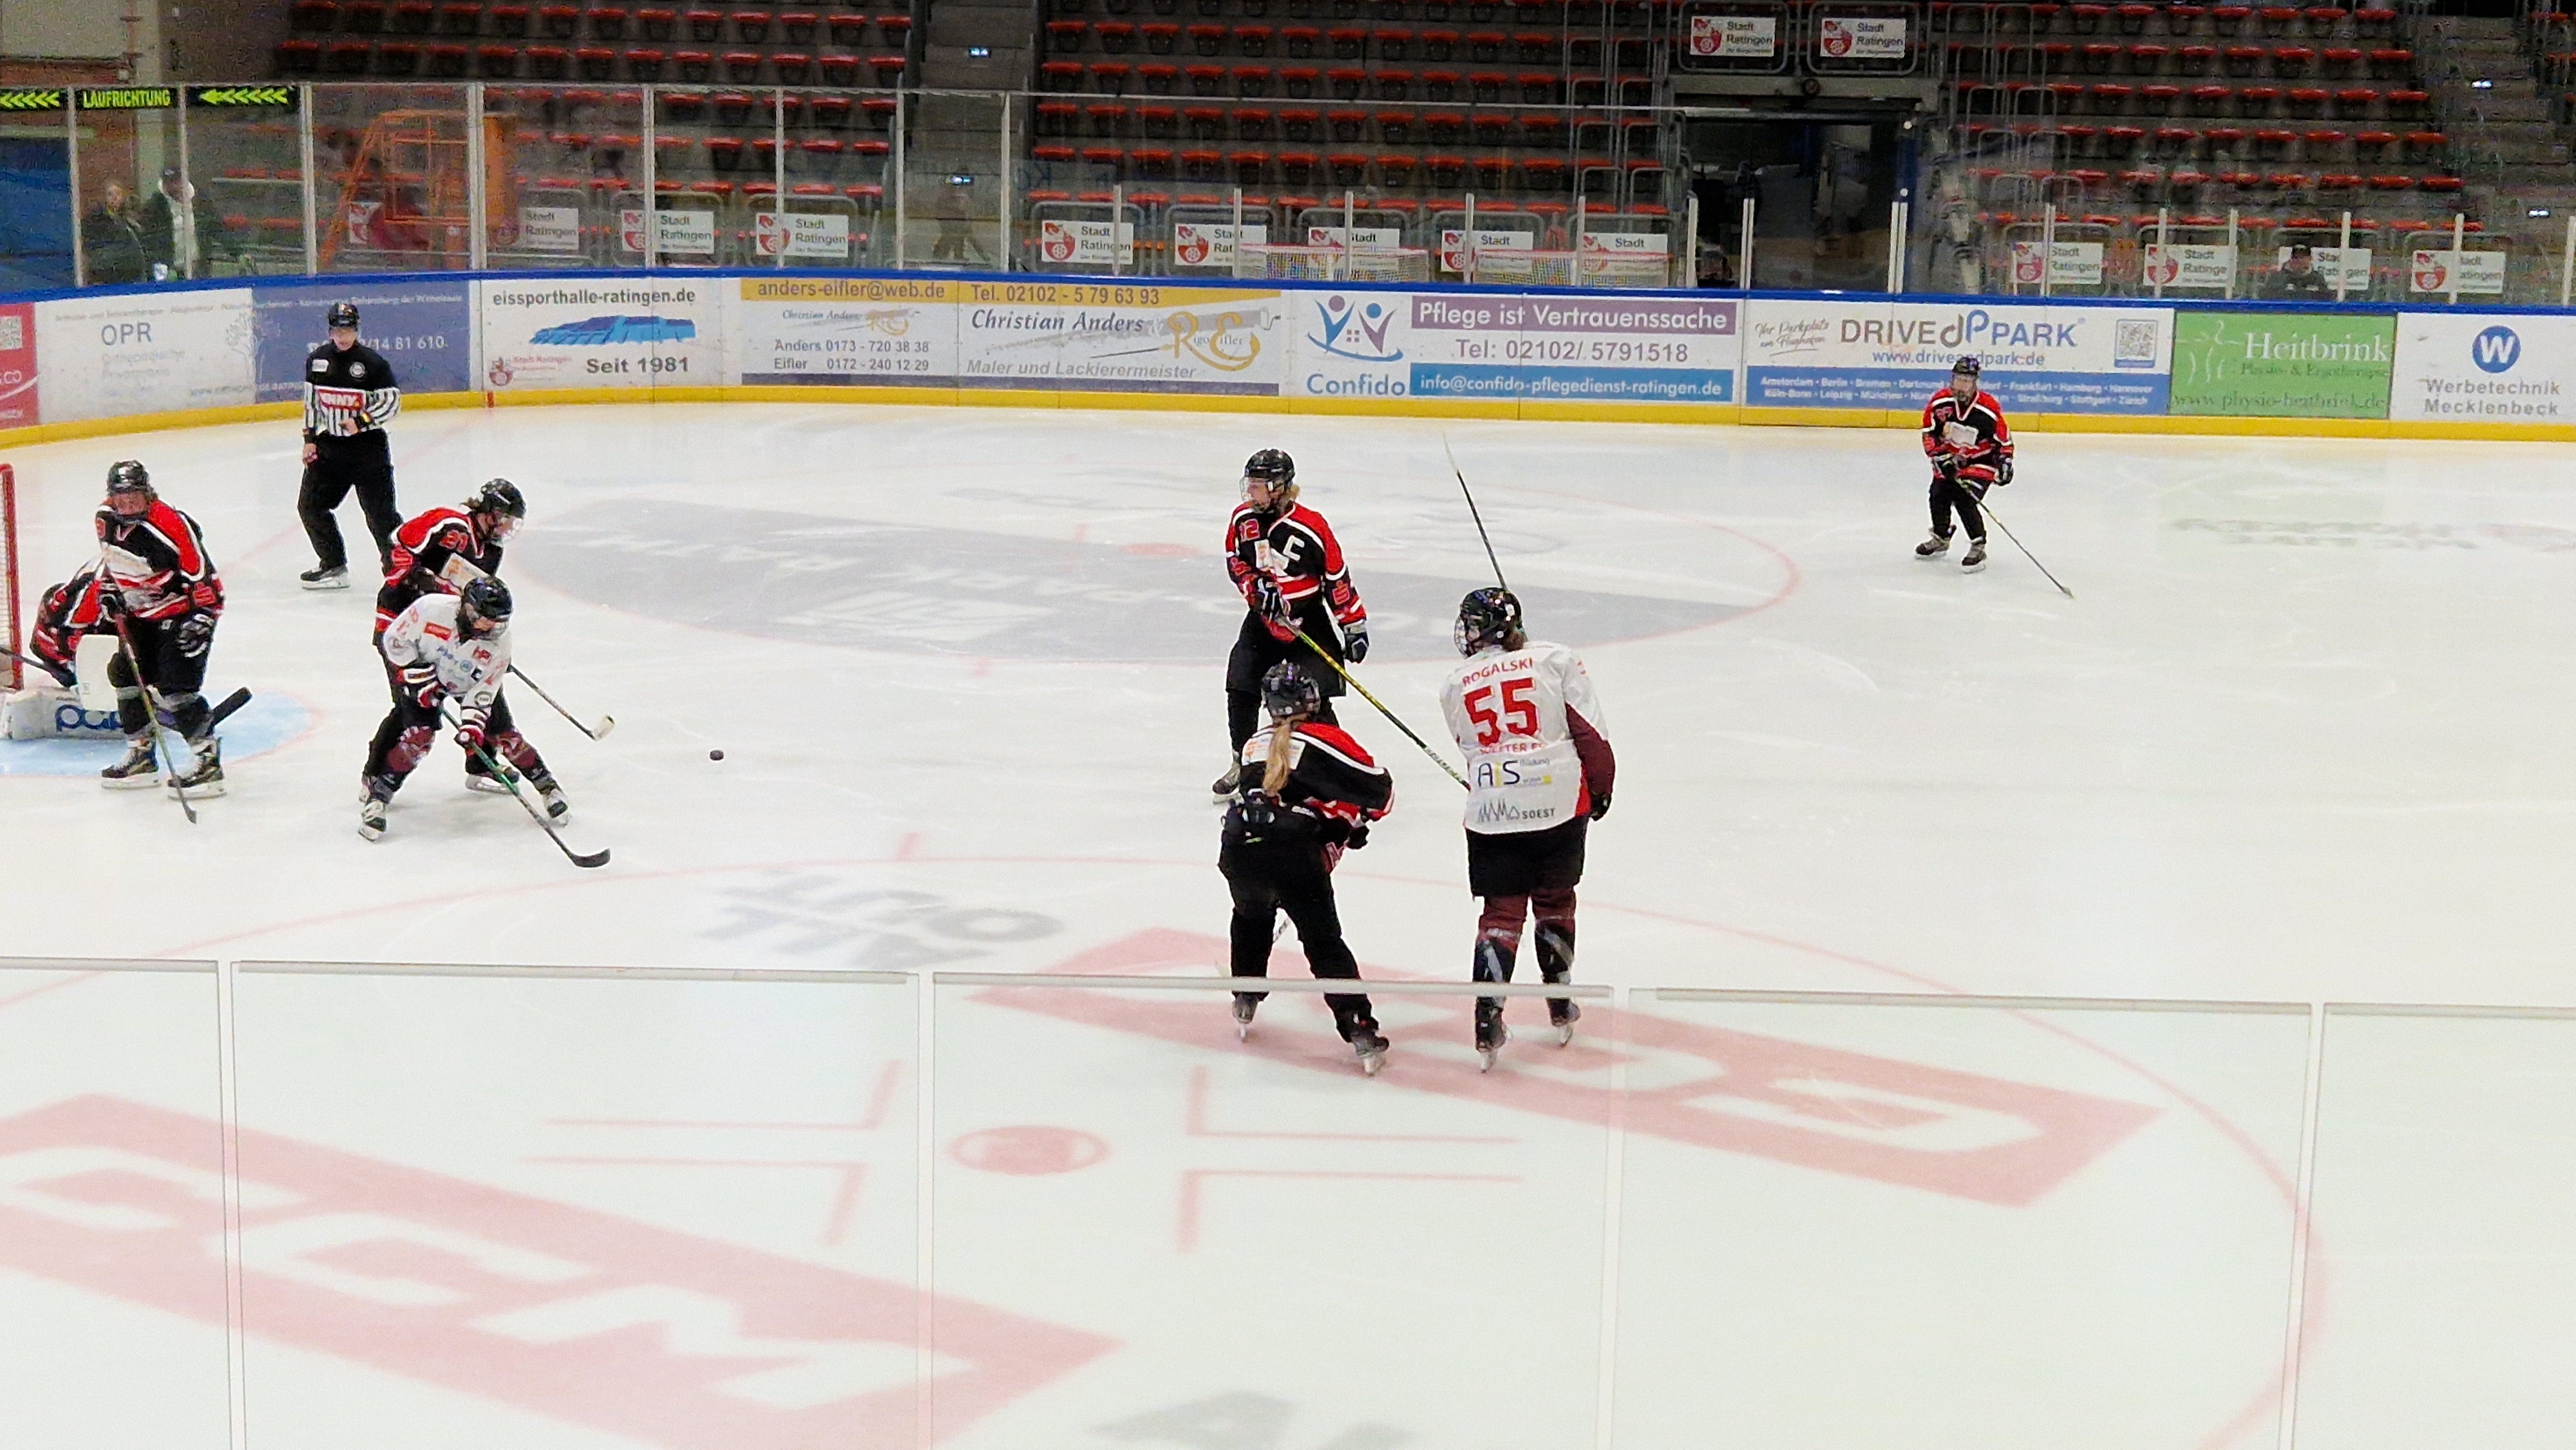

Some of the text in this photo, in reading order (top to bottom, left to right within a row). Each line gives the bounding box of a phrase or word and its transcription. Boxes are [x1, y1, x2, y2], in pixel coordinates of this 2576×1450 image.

[1727, 21, 1754, 31] Stadt
[1857, 22, 1884, 32] Stadt
[83, 89, 171, 108] LAUFRICHTUNG
[661, 215, 690, 225] Stadt
[795, 219, 825, 229] Stadt
[661, 230, 712, 243] Ratingen
[795, 232, 846, 246] Ratingen
[1081, 226, 1110, 236] Stadt
[1214, 229, 1244, 239] Stat
[1481, 235, 1510, 245] Stadt
[1615, 238, 1645, 248] Stadt
[2184, 249, 2214, 260] Stadt
[2183, 264, 2227, 278] Ratinge
[493, 288, 696, 308] eissporthalle-ratingen.de
[758, 281, 945, 301] anders-eifler@web.de
[971, 284, 1000, 301] Tel.
[1007, 286, 1056, 303] 02102
[1074, 287, 1083, 303] 5
[1090, 287, 1109, 304] 79
[1115, 288, 1133, 305] 63
[1140, 288, 1160, 305] 93
[971, 308, 1064, 331] Christian
[1072, 312, 1145, 333] Anders
[1420, 303, 1728, 329] Pflege ist Vertrauenssache
[101, 322, 151, 346] OPR
[1841, 319, 1937, 344] DRIVE
[1991, 321, 2078, 347] PARK
[395, 337, 411, 350] 81
[775, 339, 822, 352] Anders
[826, 339, 856, 352] 0173
[869, 340, 891, 352] 720
[896, 341, 910, 353] 38
[914, 341, 929, 353] 38
[1456, 339, 1689, 362] Tel: 02102/ 5791518
[2245, 332, 2390, 362] Heitbrink
[2479, 335, 2516, 364] W
[587, 357, 689, 373] Seit 1981
[774, 357, 808, 370] Eifler
[827, 358, 857, 370] 0172
[869, 359, 891, 371] 240
[896, 359, 910, 371] 12
[915, 359, 929, 372] 29
[967, 360, 1197, 379] Maler und Lackierermeister
[1307, 373, 1405, 397] Confido
[1421, 375, 1722, 396] info@confido-pflegedienst-ratingen.de
[2425, 378, 2561, 395] Werbetechnik
[2424, 399, 2559, 416] Mecklenbeck
[1240, 518, 1260, 541] 12
[1462, 657, 1533, 686] ROGALSKI
[1463, 677, 1540, 748] 55
[1522, 807, 1556, 820] SOEST
